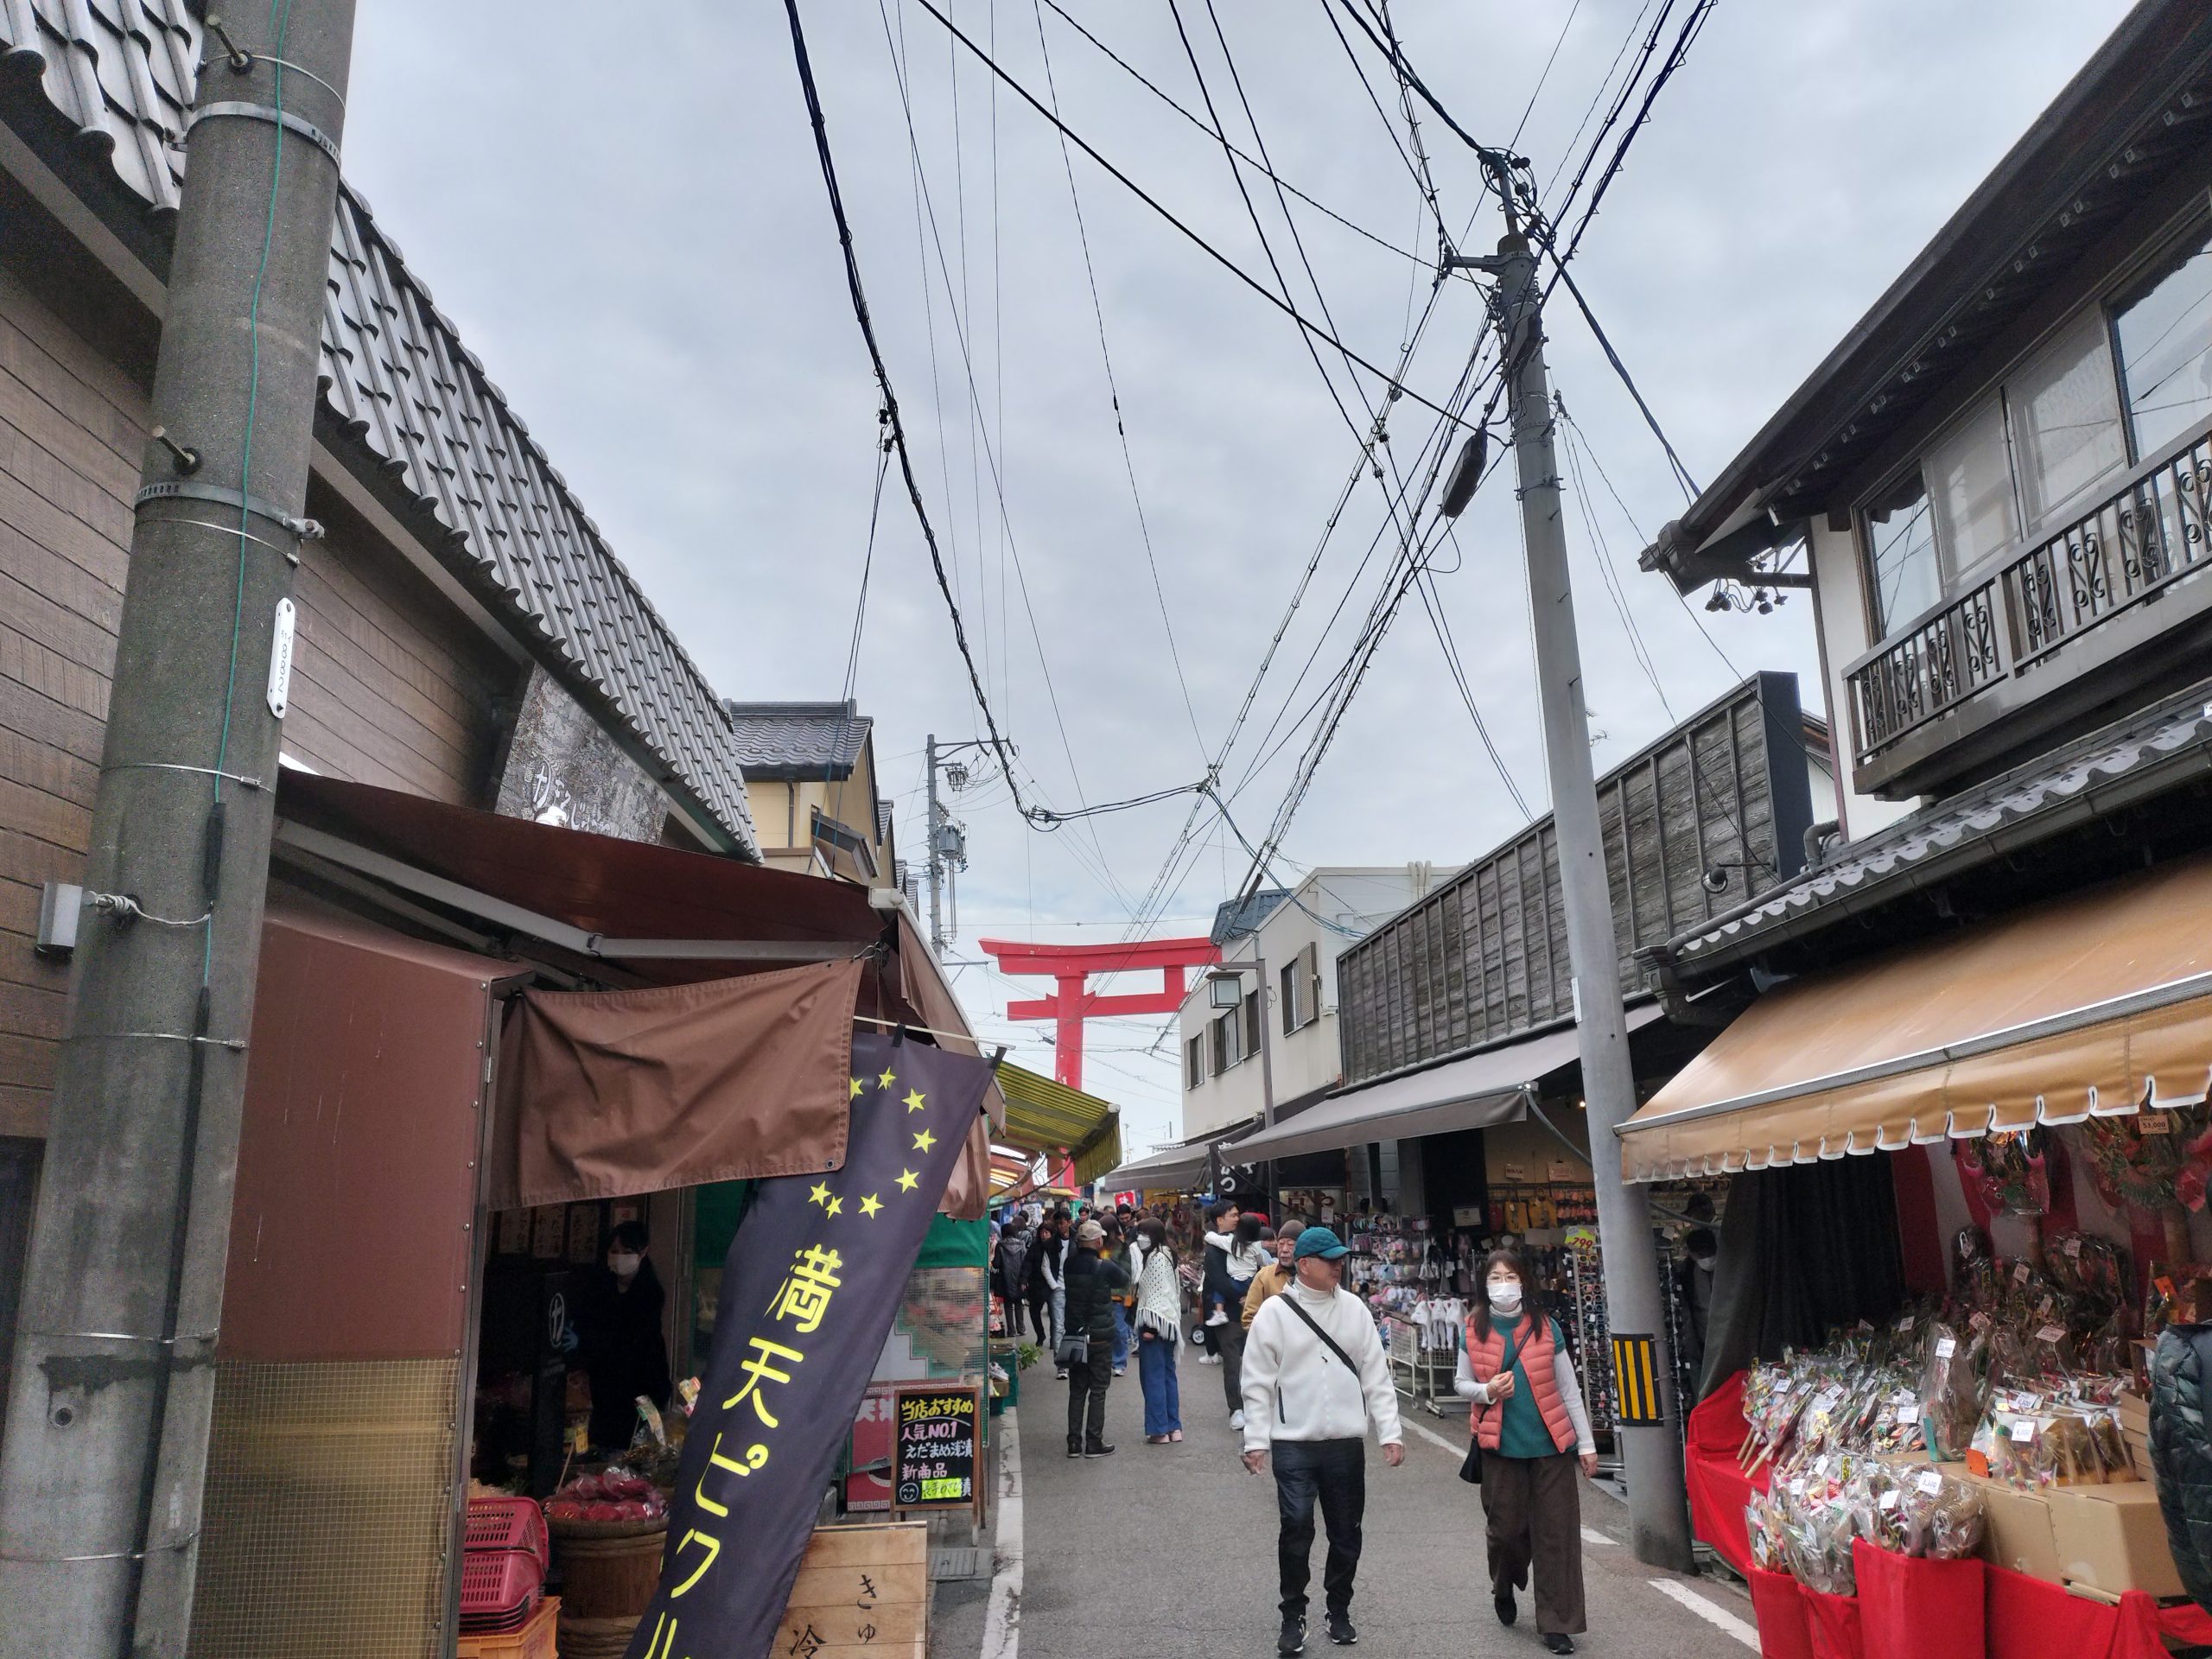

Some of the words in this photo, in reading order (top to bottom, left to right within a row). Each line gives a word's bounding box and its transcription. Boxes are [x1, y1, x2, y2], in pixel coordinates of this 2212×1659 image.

[277, 644, 288, 693] 882
[901, 1397, 974, 1421] 当店おすすめ
[901, 1462, 947, 1481] 新商品
[790, 1624, 827, 1659] 冷
